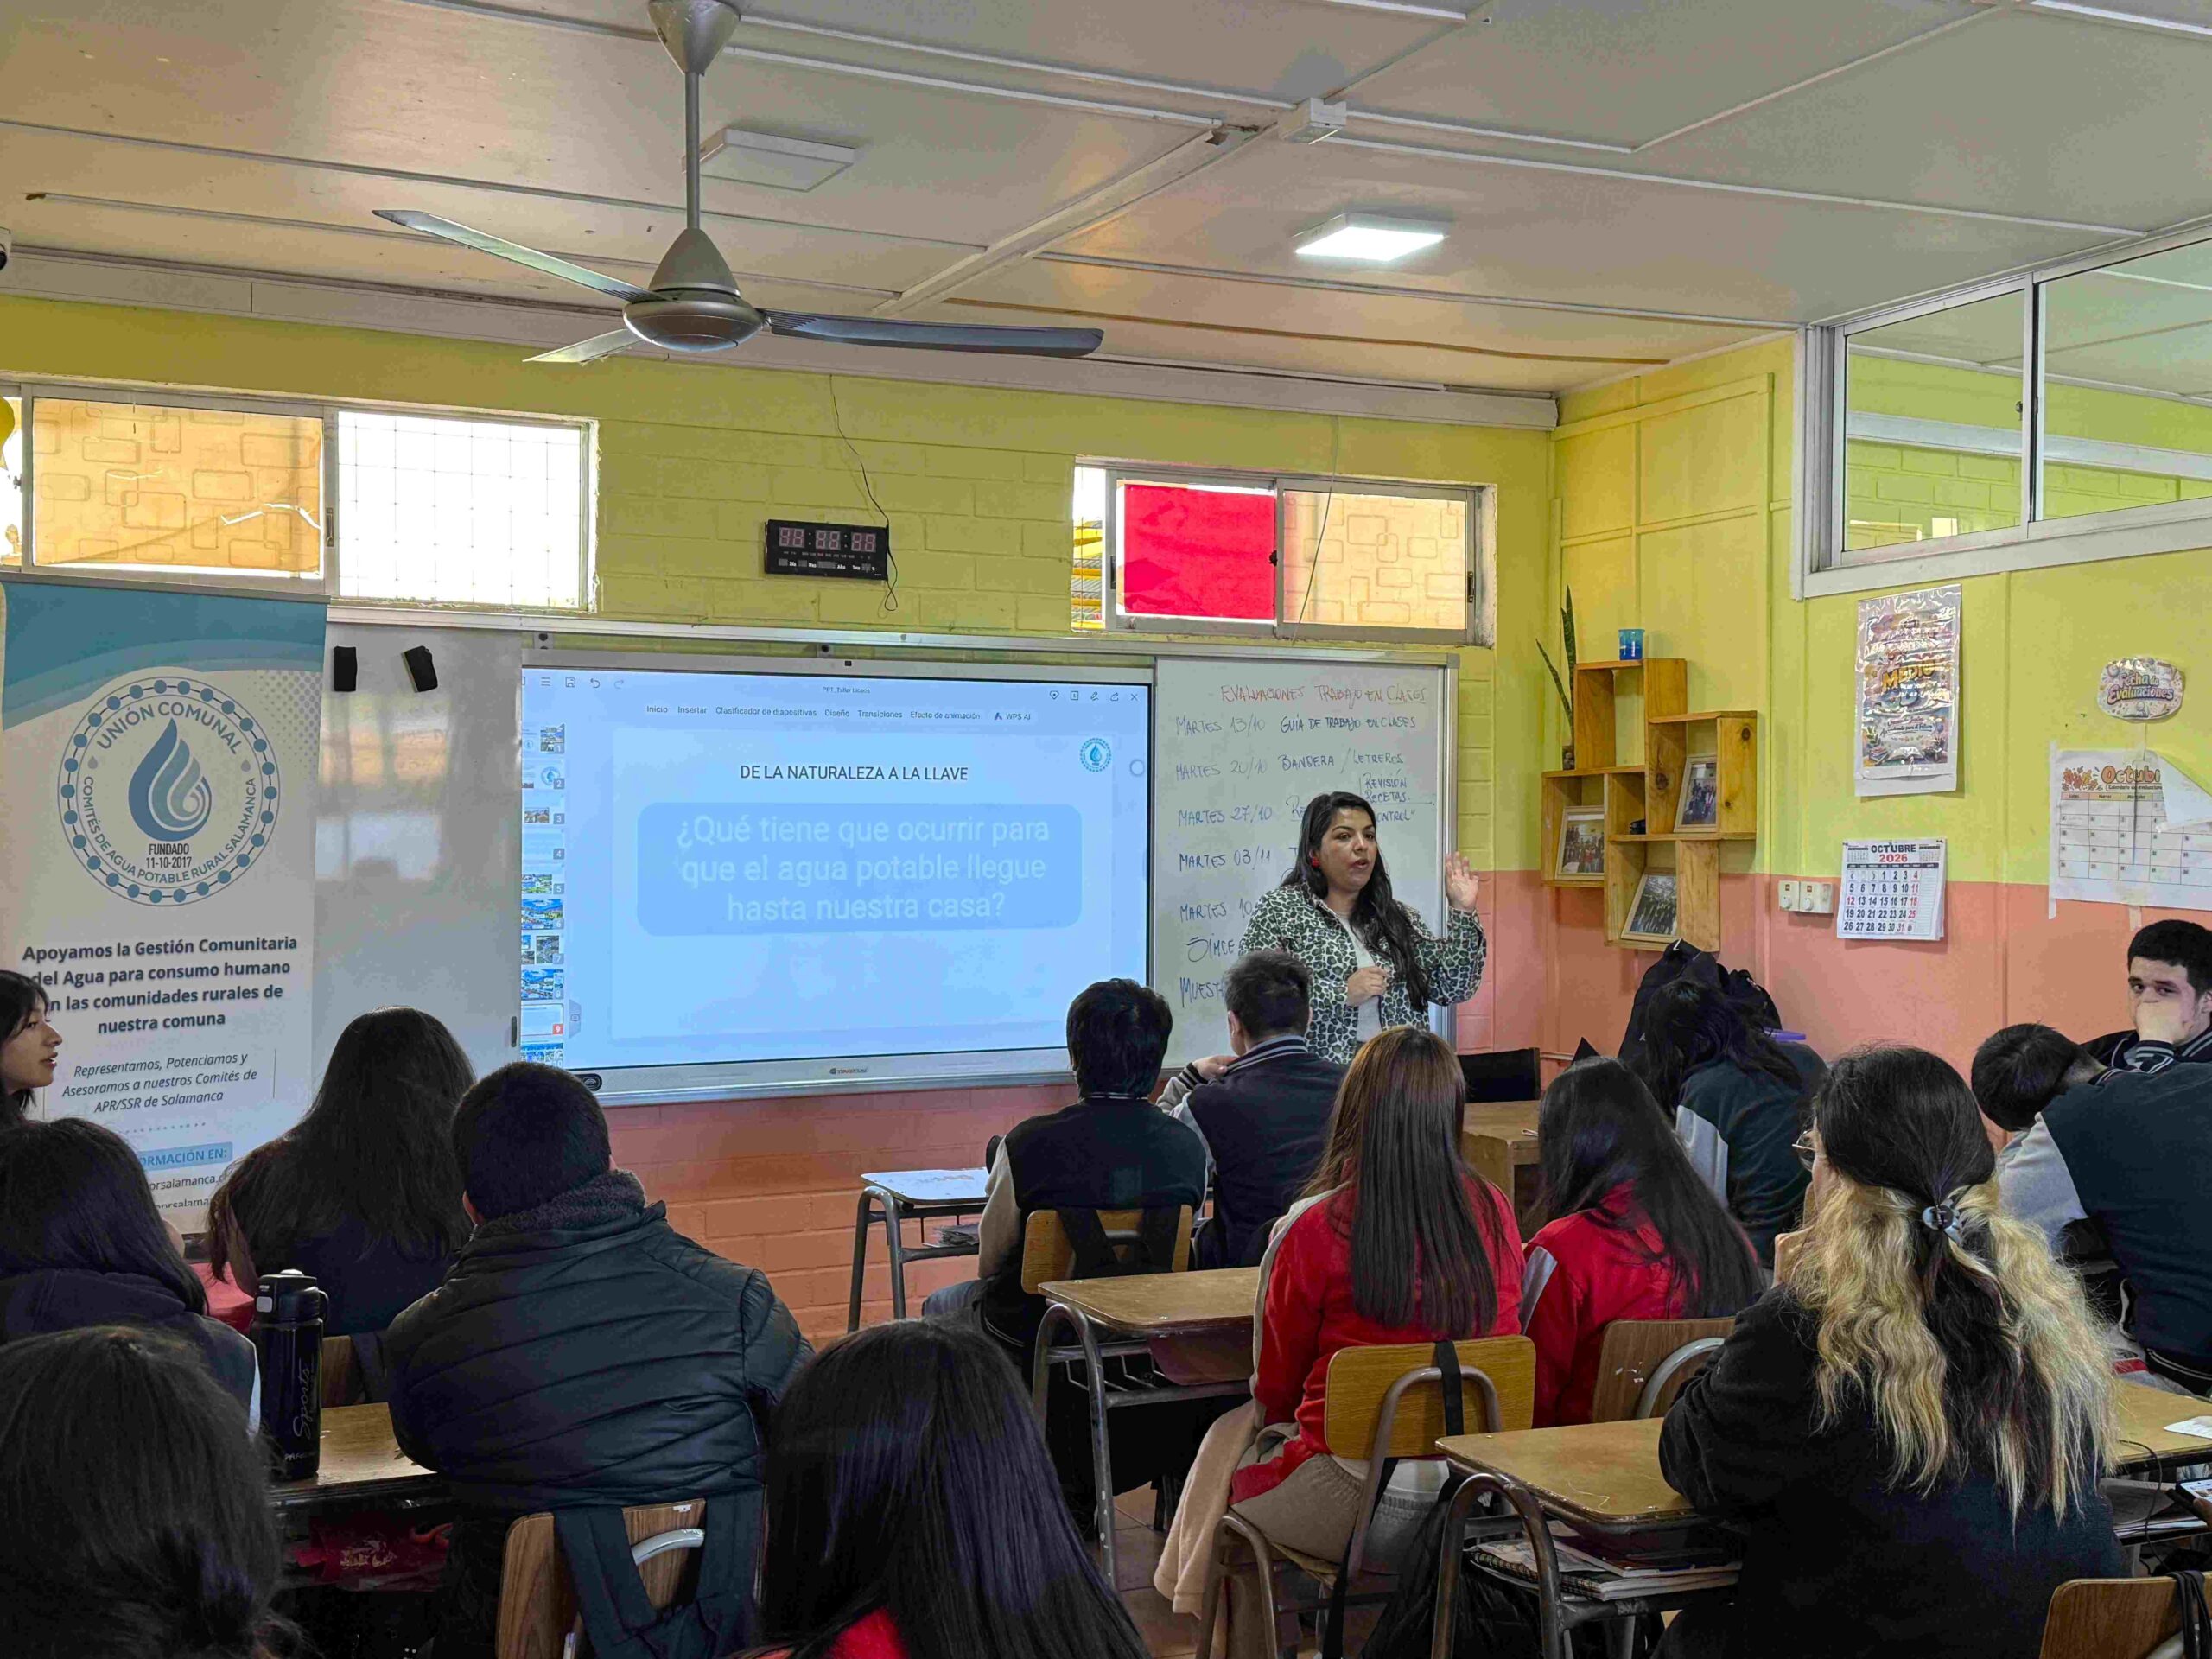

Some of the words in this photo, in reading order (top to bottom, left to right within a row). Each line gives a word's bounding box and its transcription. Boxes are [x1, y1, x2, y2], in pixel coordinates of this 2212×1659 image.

[2119, 671, 2150, 689] Fecha
[2107, 684, 2174, 705] Evaluaciones
[677, 706, 708, 715] Insertar
[715, 706, 760, 715] Clasificador
[762, 707, 772, 715] de
[773, 708, 817, 718] diapositivas
[824, 709, 850, 717] Diseño
[858, 709, 903, 718] Transiciones
[910, 710, 932, 719] Efecto
[97, 704, 155, 749] UNIÓN
[158, 702, 242, 754] COMUNAL
[1176, 715, 1223, 736] MARTES
[1230, 714, 1265, 737] 13/10
[1308, 718, 1321, 729] DE
[1325, 716, 1361, 732] TRABAJO
[741, 766, 760, 779] DE
[764, 766, 784, 779] LA
[787, 766, 885, 780] NATURALEZA
[888, 766, 899, 780] A
[903, 766, 920, 780] LA
[925, 766, 969, 780] LLAVE
[1176, 764, 1221, 781] MARTES
[1230, 757, 1268, 779] 20/10
[1278, 754, 1334, 771] BANDERA
[1354, 749, 1404, 764] LETREROS
[1363, 769, 1408, 789] REVISIÓN
[1179, 810, 1225, 826] MARTES
[1230, 804, 1273, 823] 27/10
[82, 776, 102, 835] COMITÉS
[95, 834, 111, 852] DE
[106, 850, 136, 877] AGUA
[137, 869, 191, 883] POTABLE
[190, 852, 227, 878] RURAL
[225, 778, 257, 853] SALAMANCA
[677, 815, 751, 849] ¿Qué
[758, 816, 830, 842] tiene
[838, 822, 890, 847] que
[897, 818, 984, 842] ocurrir
[992, 821, 1049, 846] para
[149, 843, 189, 855] FUNDADO
[1179, 853, 1227, 871] MARTES
[1234, 845, 1270, 870] 03/11
[1871, 844, 1916, 854] OCTUBRE
[1879, 854, 1908, 862] 2026
[146, 856, 192, 868] 11-10-2017
[682, 861, 736, 888] que
[743, 855, 768, 880] el
[776, 860, 848, 888] agua
[856, 854, 960, 887] potable
[968, 855, 1046, 884] llegue
[1882, 871, 1886, 880] 1
[1893, 871, 1897, 880] 2
[1904, 871, 1908, 880] 3
[1914, 871, 1918, 880] 4
[728, 894, 808, 922] hasta
[816, 894, 918, 920] nuestra
[928, 892, 1005, 918] casa?
[1180, 902, 1227, 922] MARTES
[1847, 897, 1854, 906] 12
[1858, 897, 1866, 906] 13
[1869, 897, 1877, 906] 14
[1880, 897, 1888, 906] 15
[1891, 897, 1897, 906] 16
[1900, 897, 1908, 906] 17
[1910, 897, 1917, 906] 18
[1846, 910, 1854, 918] 19
[1857, 910, 1865, 918] 20
[1868, 910, 1875, 918] 21
[1878, 910, 1887, 918] 22
[1890, 910, 1897, 918] 23
[1899, 910, 1906, 918] 24
[1908, 910, 1916, 918] 25
[1844, 922, 1853, 931] 26
[1856, 922, 1864, 931] 27
[1866, 922, 1874, 931] 28
[1878, 922, 1886, 931] 29
[1888, 922, 1895, 931] 30
[1897, 922, 1904, 931] 31
[22, 944, 113, 963] Apoyamos
[116, 942, 131, 957] la
[135, 938, 194, 956] Gestión
[198, 937, 298, 952] Comunitaria
[32, 970, 59, 986] del
[62, 969, 105, 988] Agua
[109, 968, 144, 986] para
[148, 963, 219, 980] consumo
[224, 960, 290, 976] humano
[66, 995, 89, 1011] las
[93, 990, 199, 1009] comunidades
[202, 987, 259, 1005] rurales
[263, 984, 283, 998] de
[1180, 977, 1224, 1007] MUEST
[98, 1017, 158, 1034] nuestra
[162, 1014, 226, 1029] comuna
[74, 1058, 162, 1077] Representamos,
[166, 1054, 238, 1070] Potenciamos
[239, 1053, 248, 1065] y
[62, 1080, 130, 1097] Asesoramos
[132, 1080, 141, 1090] a
[143, 1074, 192, 1090] nuestros
[195, 1070, 240, 1085] Comités
[243, 1069, 257, 1081] de
[94, 1097, 142, 1114] APR/SSR
[143, 1096, 159, 1108] de
[161, 1091, 224, 1107] Salamanca
[207, 1147, 227, 1159] EN:
[293, 1357, 312, 1440] Sports
